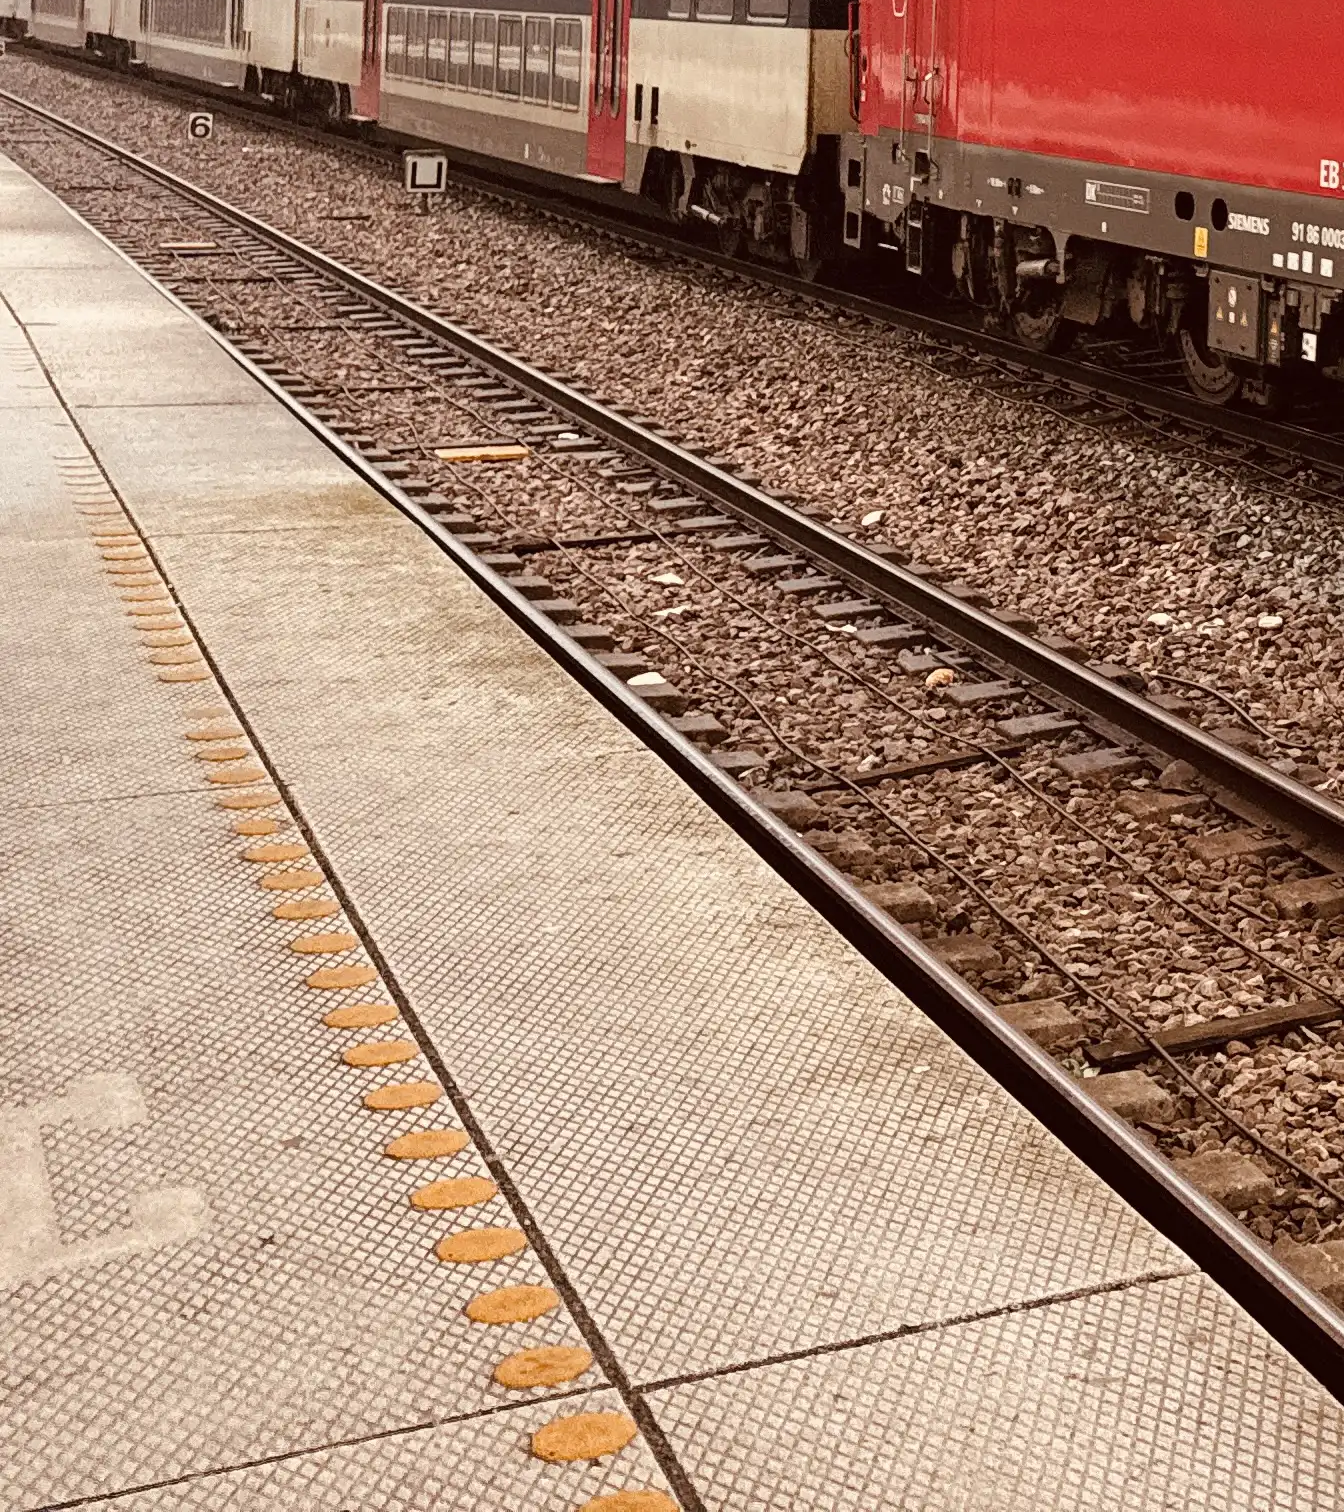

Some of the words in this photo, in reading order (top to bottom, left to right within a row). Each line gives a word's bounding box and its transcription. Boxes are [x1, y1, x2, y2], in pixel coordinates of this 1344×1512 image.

[191, 116, 211, 138] 6
[1319, 159, 1340, 188] EB
[1227, 212, 1270, 235] SIEMENS
[1291, 221, 1304, 242] 91
[1306, 224, 1320, 245] 86
